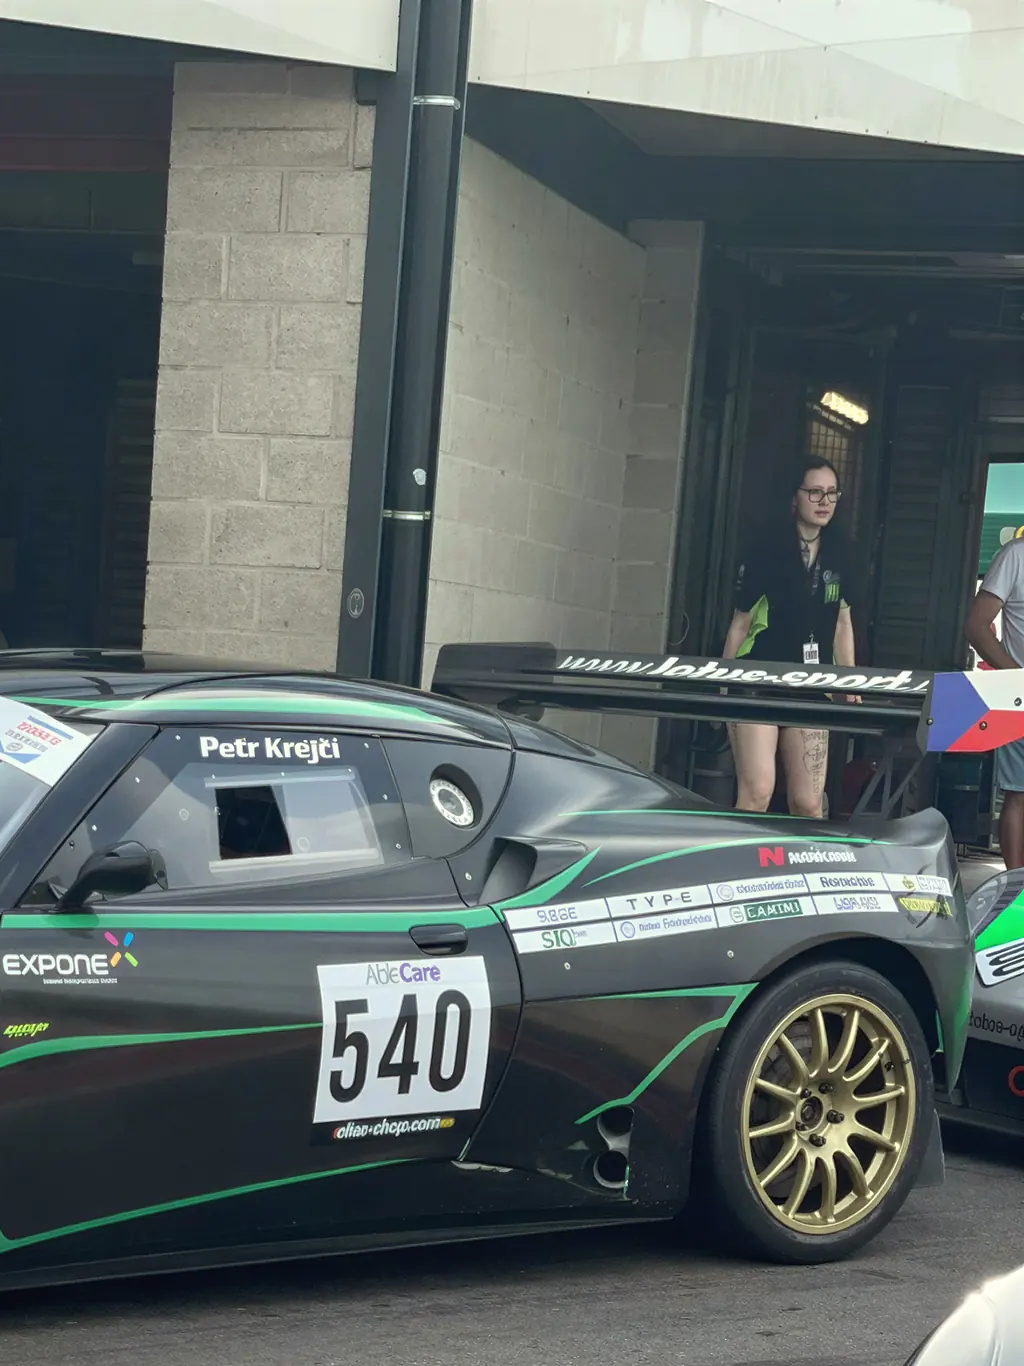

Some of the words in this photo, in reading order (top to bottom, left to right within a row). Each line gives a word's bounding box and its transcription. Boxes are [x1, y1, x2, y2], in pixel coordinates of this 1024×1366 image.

[199, 736, 260, 758] Petr
[264, 736, 341, 764] Krejči
[626, 891, 693, 911] TYPE
[329, 989, 472, 1103] 540
